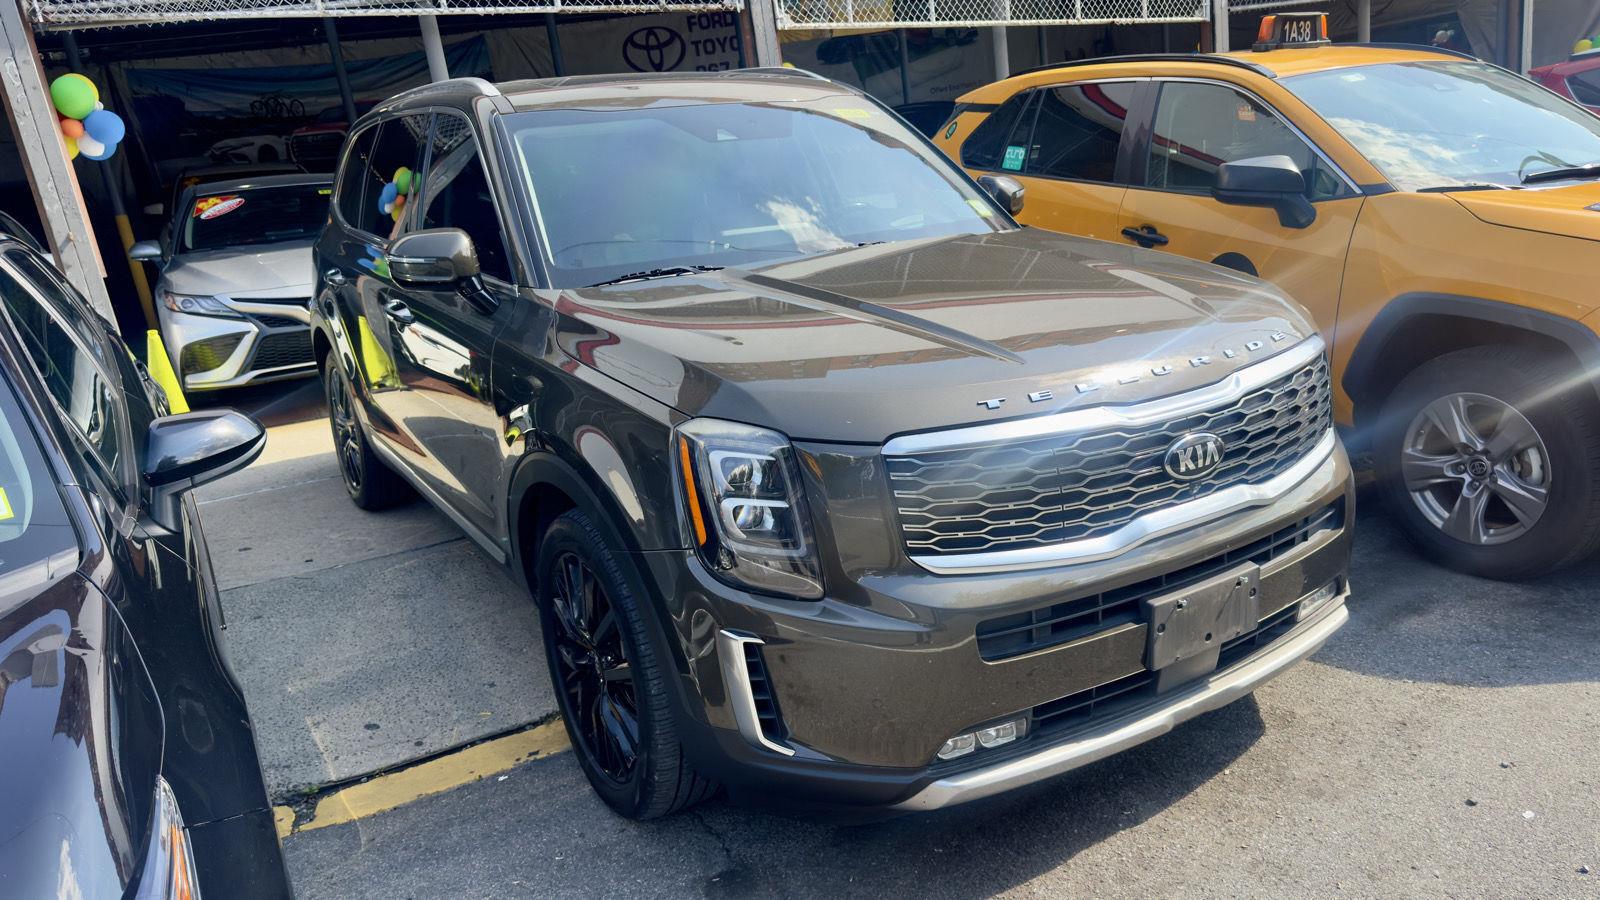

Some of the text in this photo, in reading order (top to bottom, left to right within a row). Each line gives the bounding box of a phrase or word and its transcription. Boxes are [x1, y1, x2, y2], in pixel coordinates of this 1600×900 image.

[687, 12, 735, 32] FORD
[1284, 21, 1311, 42] 1A38
[977, 331, 1286, 409] TELLURIDE
[1177, 441, 1219, 473] KIA
